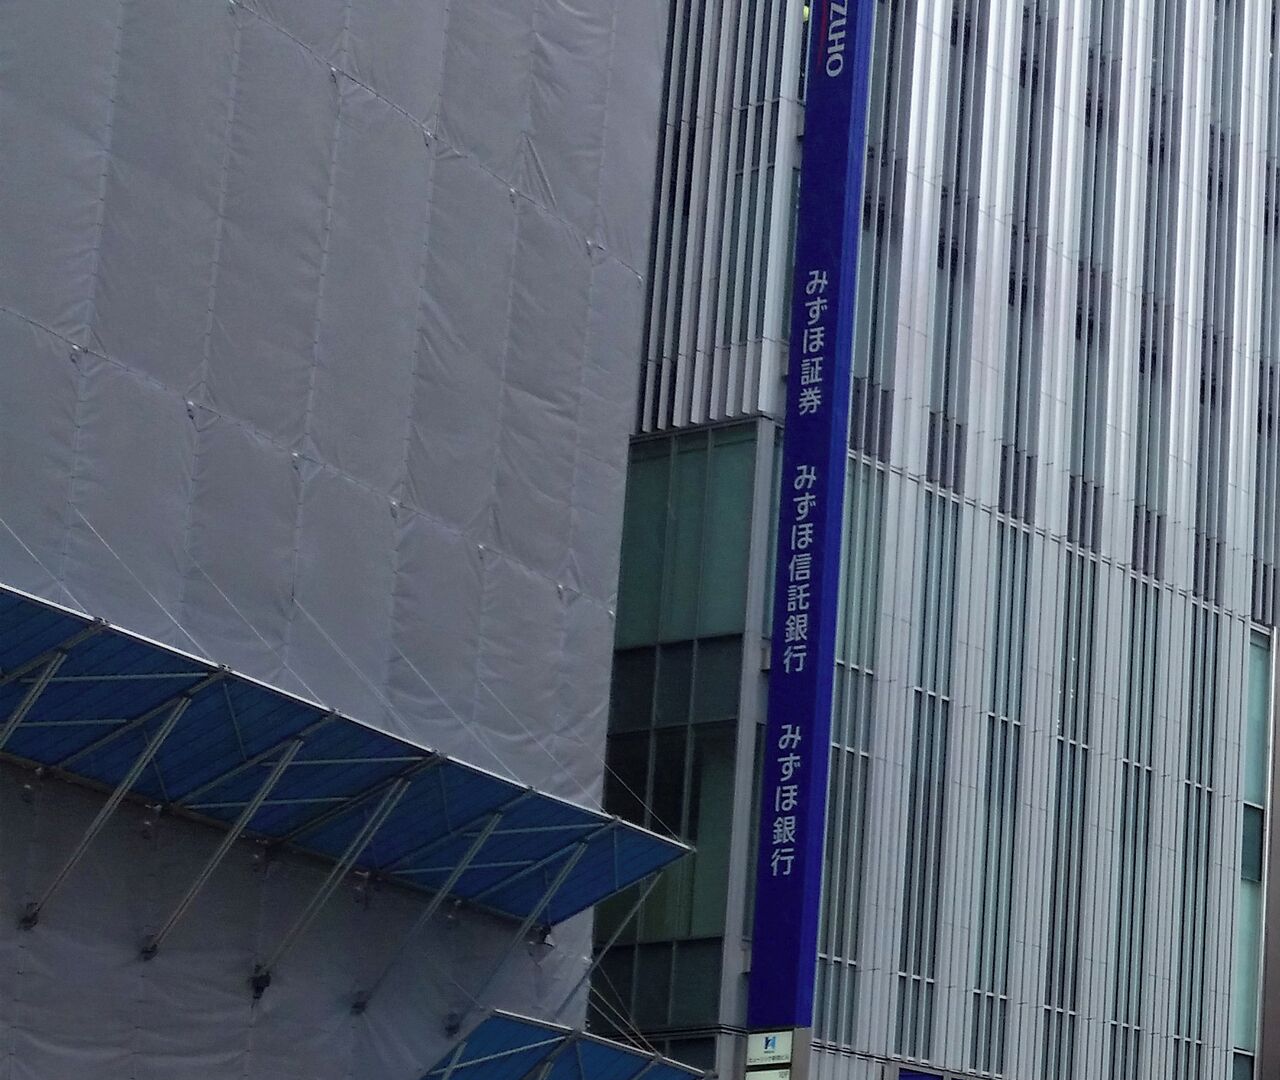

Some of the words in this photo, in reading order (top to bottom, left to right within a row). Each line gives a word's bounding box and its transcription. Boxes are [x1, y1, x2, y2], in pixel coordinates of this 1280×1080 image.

[798, 270, 829, 415] みずほ証券
[782, 464, 817, 673] みずほ信託銀行
[771, 723, 802, 877] みずほ銀行
